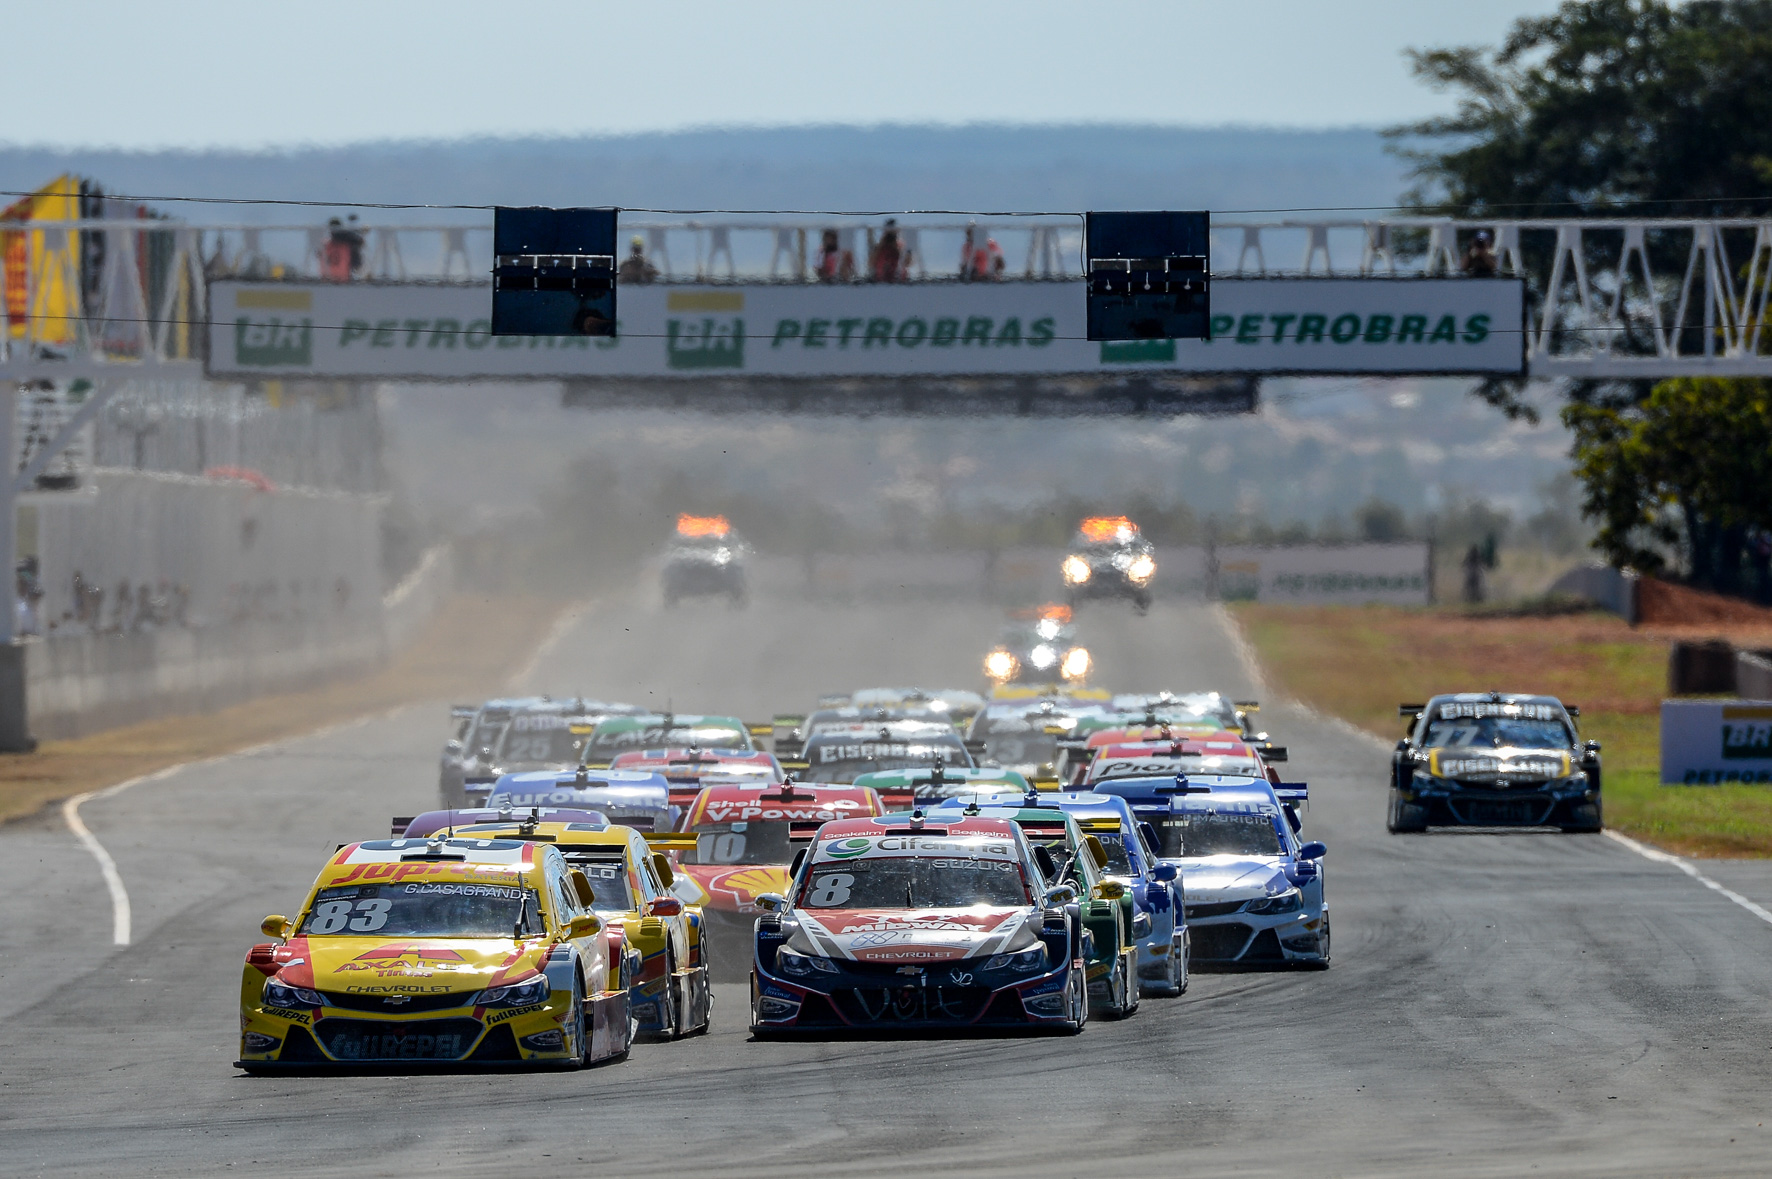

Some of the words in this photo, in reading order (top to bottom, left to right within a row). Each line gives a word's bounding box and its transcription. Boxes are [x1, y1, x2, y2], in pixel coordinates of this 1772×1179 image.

[771, 316, 1056, 348] PETROBRAS
[1206, 312, 1491, 345] PETROBRAS
[1100, 760, 1257, 776] Pioner
[707, 800, 762, 808] Shell
[706, 807, 850, 822] V-Power
[824, 830, 882, 840] Seakalm
[697, 833, 747, 864] 10
[933, 859, 1014, 873] SUZUKI
[464, 873, 530, 884] BATERIAS
[809, 873, 855, 907] 8
[309, 898, 393, 935] 83
[841, 922, 987, 934] MIDWAY
[866, 951, 954, 960] CHEVROLET
[333, 959, 465, 974] AXALT
[345, 985, 453, 993] CHEVROLET
